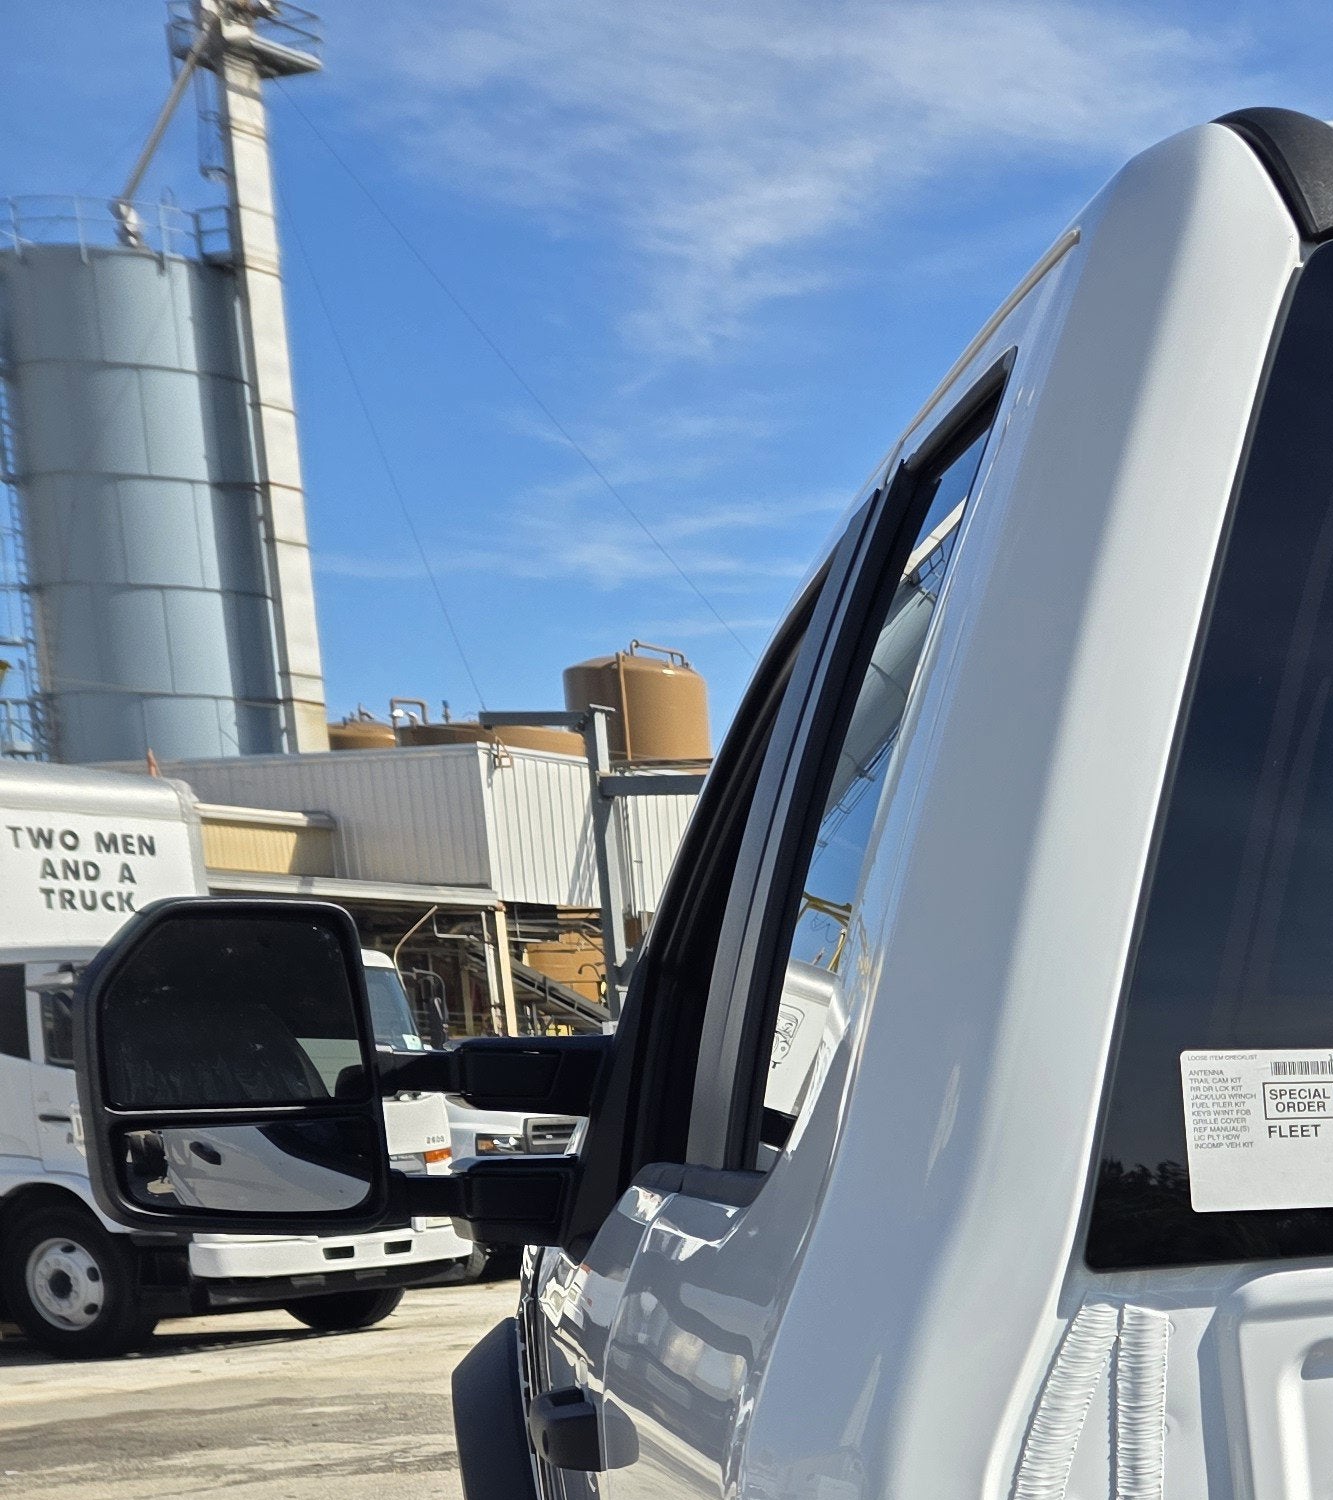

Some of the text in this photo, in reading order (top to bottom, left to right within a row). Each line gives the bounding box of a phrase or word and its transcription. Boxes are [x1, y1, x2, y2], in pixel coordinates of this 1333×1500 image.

[6, 825, 156, 857] TWO MEN
[40, 857, 137, 885] AND A
[39, 887, 135, 912] TRUCK
[1269, 1087, 1331, 1100] SPECIAL
[1275, 1101, 1327, 1113] ORDER
[1268, 1124, 1321, 1138] FLEET
